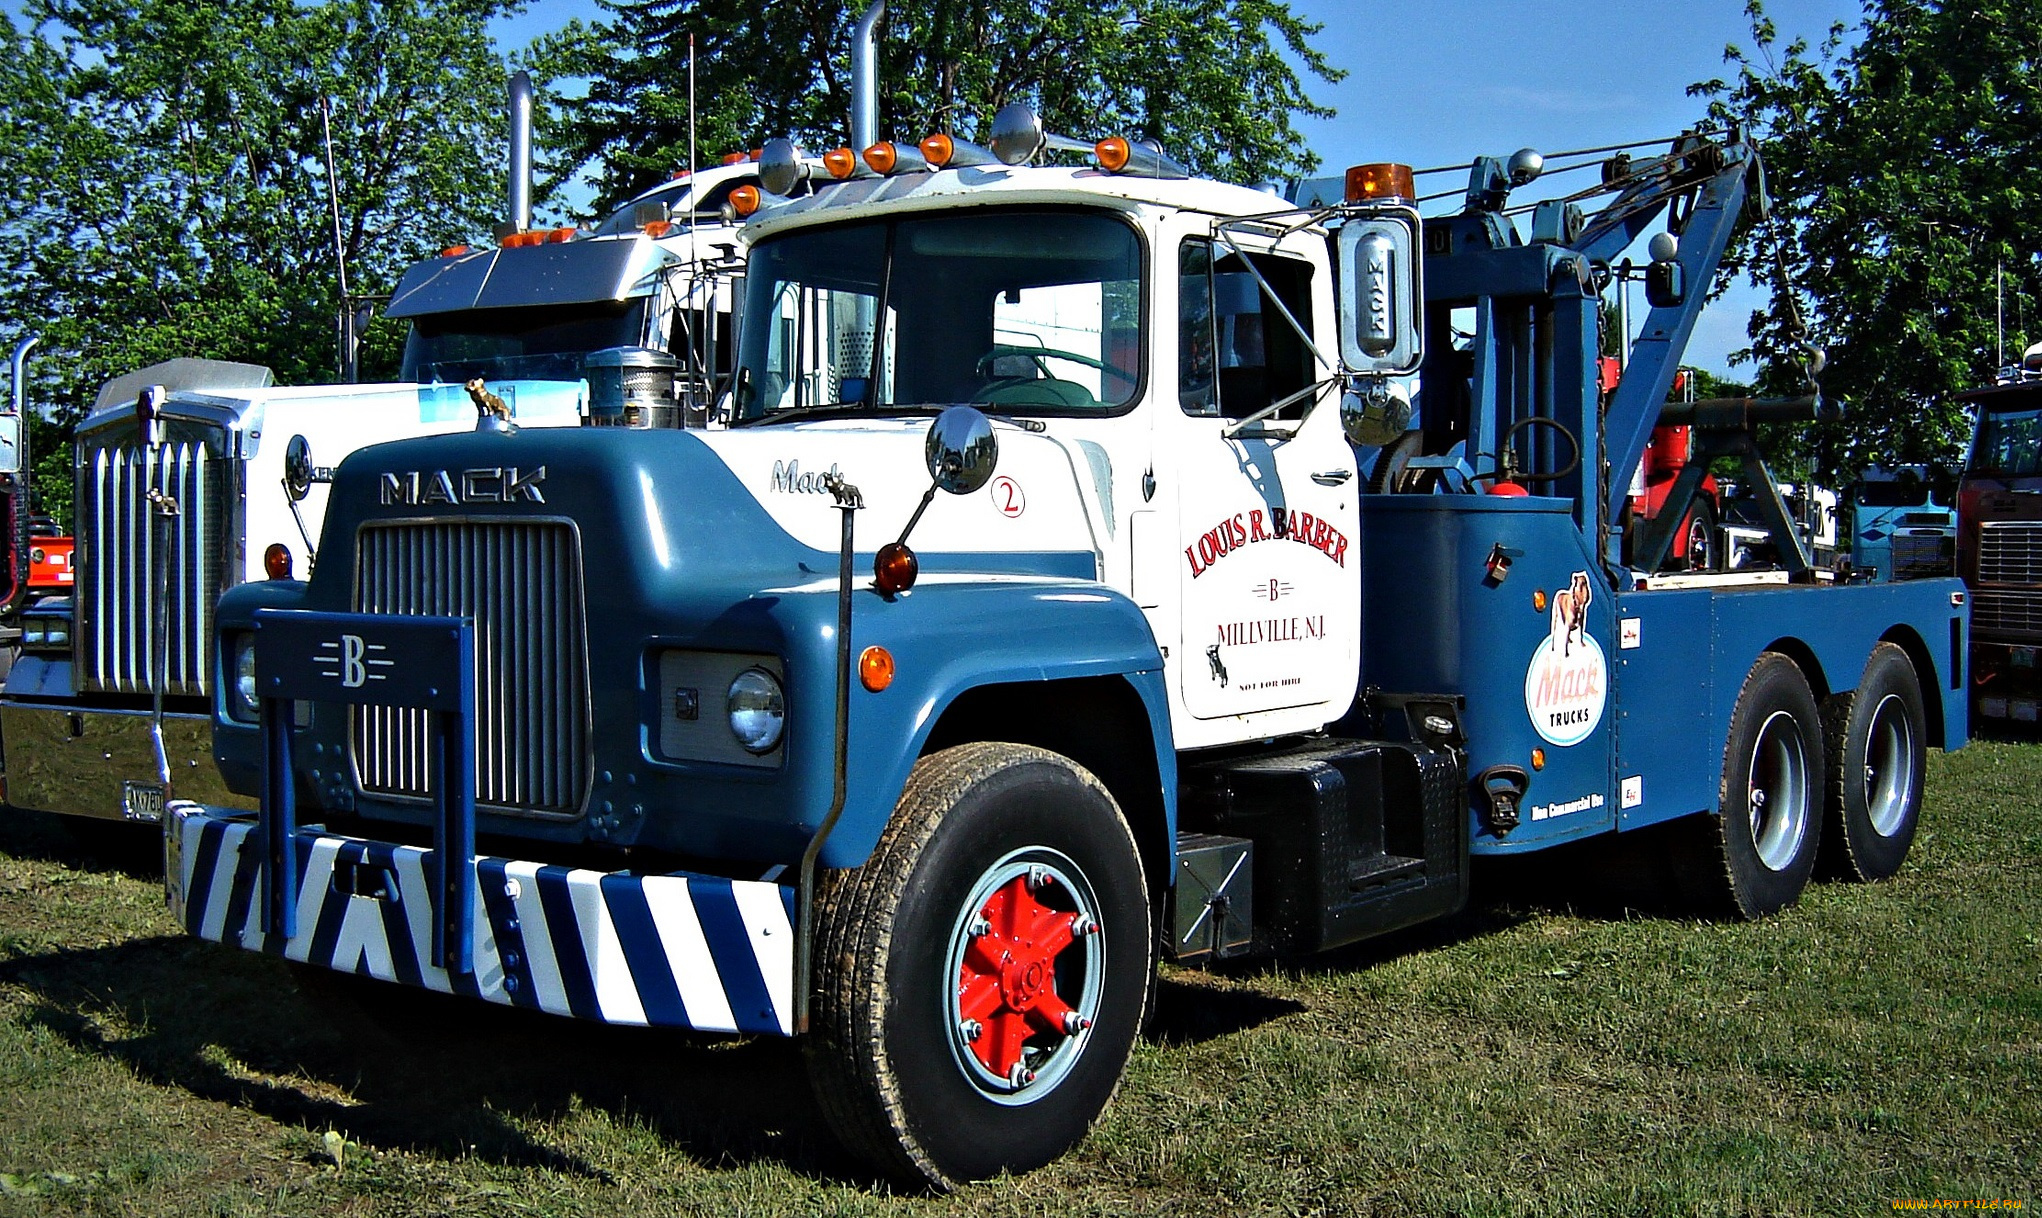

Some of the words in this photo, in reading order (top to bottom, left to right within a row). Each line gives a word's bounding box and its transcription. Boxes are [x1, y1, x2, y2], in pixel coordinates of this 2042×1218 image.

[1367, 257, 1386, 332] MACK
[380, 465, 546, 505] MACK
[1000, 482, 1019, 512] 2
[1185, 513, 1247, 579] LOUIS
[1249, 509, 1271, 543] R.
[1272, 507, 1348, 569] BARBER
[1269, 578, 1279, 601] B
[1218, 617, 1302, 646] MILLVILLE,
[1305, 615, 1326, 640] N.J.
[342, 634, 366, 688] B
[1536, 656, 1598, 708] Mack
[1550, 708, 1588, 727] TRUCKS
